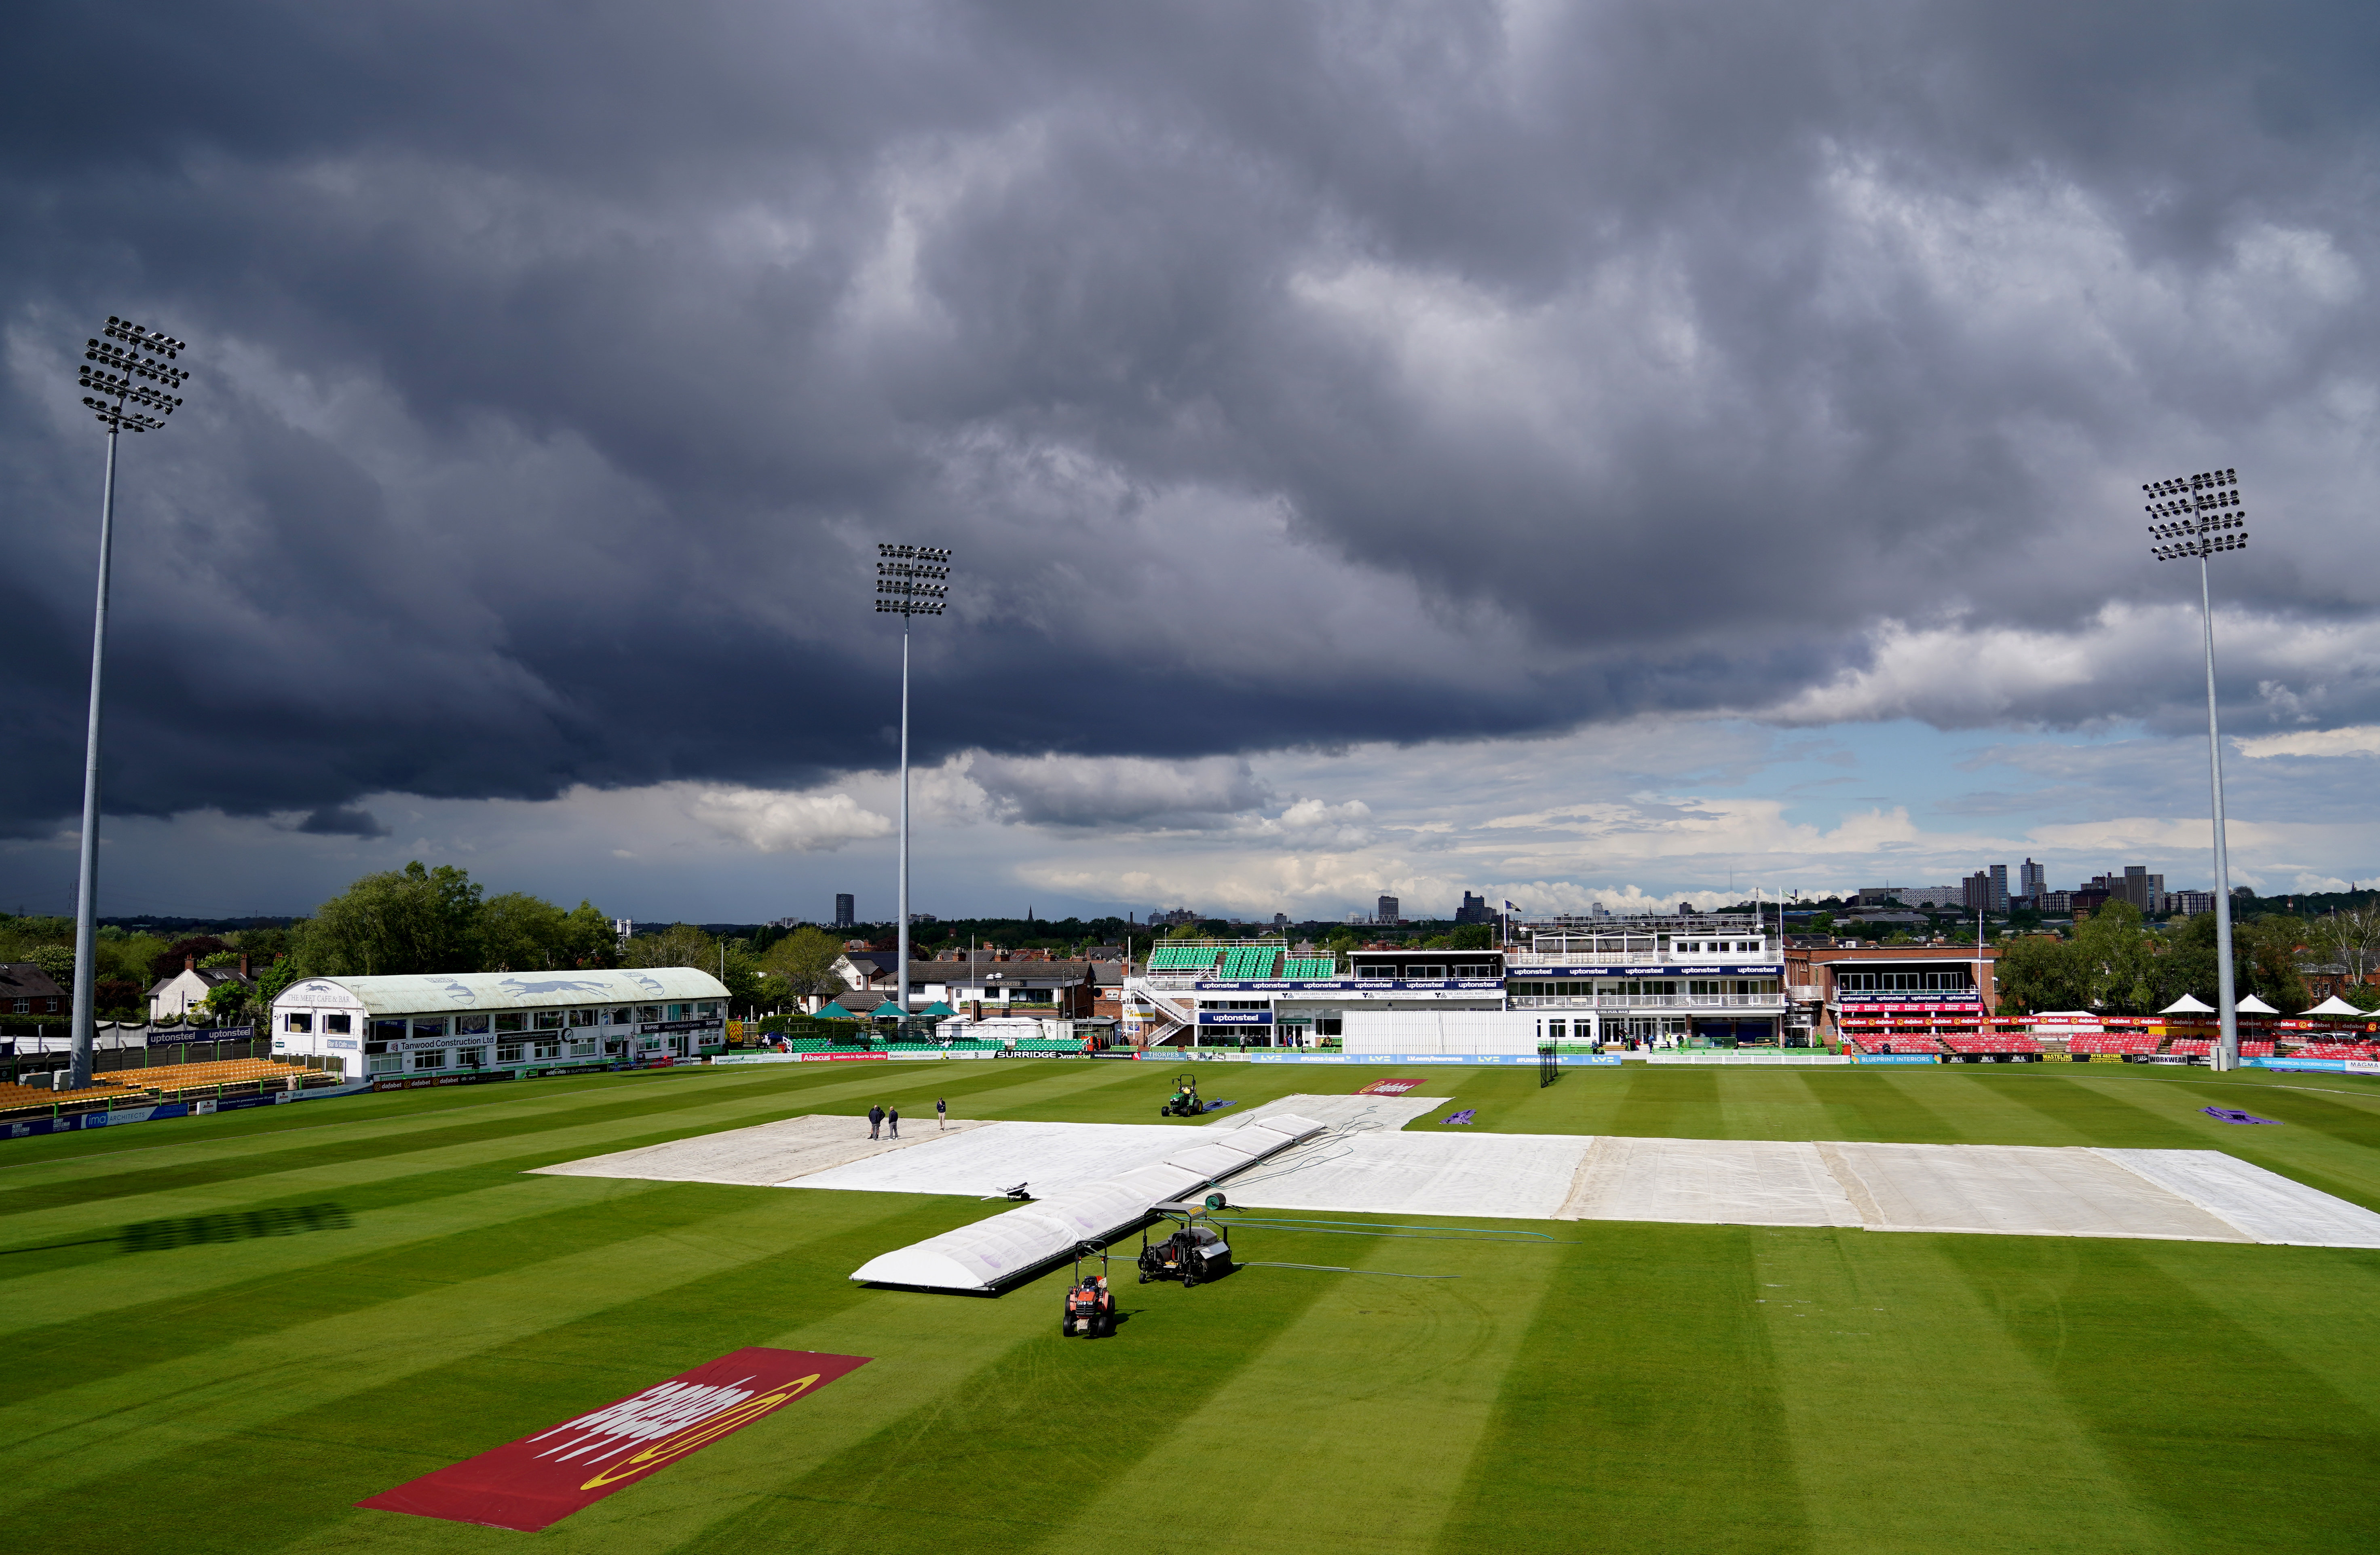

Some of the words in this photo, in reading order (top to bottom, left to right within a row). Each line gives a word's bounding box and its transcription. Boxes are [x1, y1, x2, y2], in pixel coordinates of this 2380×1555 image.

[151, 1032, 195, 1044] uptonsteel
[209, 1028, 250, 1039] uptonsteel
[401, 1041, 434, 1050] Tanwood
[436, 1037, 481, 1047] Construction
[1374, 1083, 1415, 1093] dafabet
[89, 1115, 106, 1125] ima
[110, 1112, 145, 1122] ARCHITECTS
